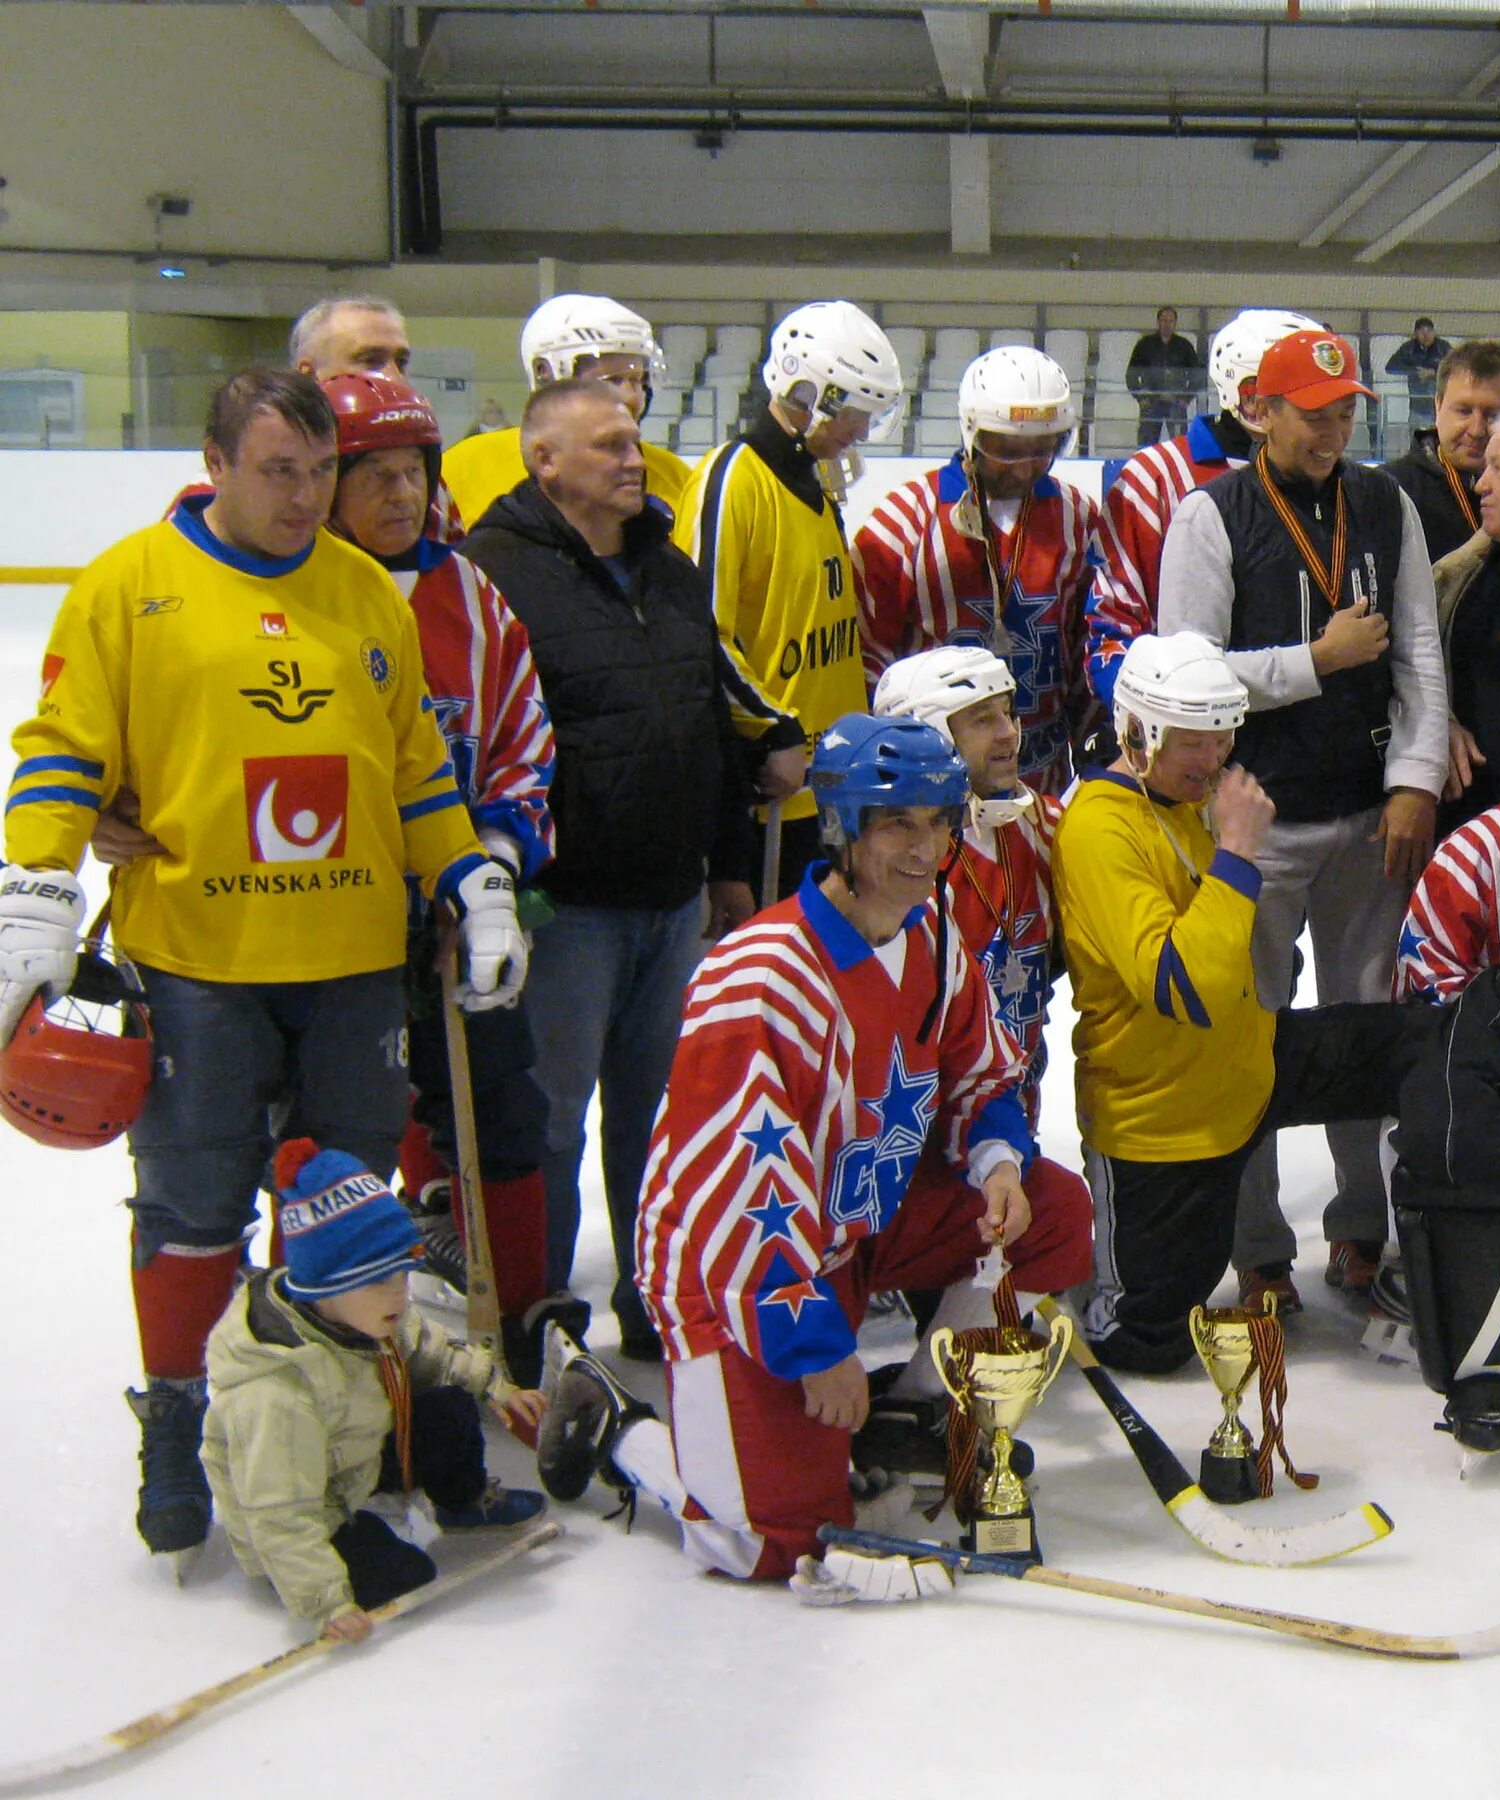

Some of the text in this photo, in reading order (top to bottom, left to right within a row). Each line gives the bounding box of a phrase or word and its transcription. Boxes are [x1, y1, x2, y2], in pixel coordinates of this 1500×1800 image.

[1225, 368, 1235, 380] 40
[823, 556, 843, 600] 10
[267, 660, 301, 689] SJ
[1, 880, 79, 907] AUER
[203, 868, 376, 897] SVENSKA SPEL
[378, 1027, 409, 1068] 18
